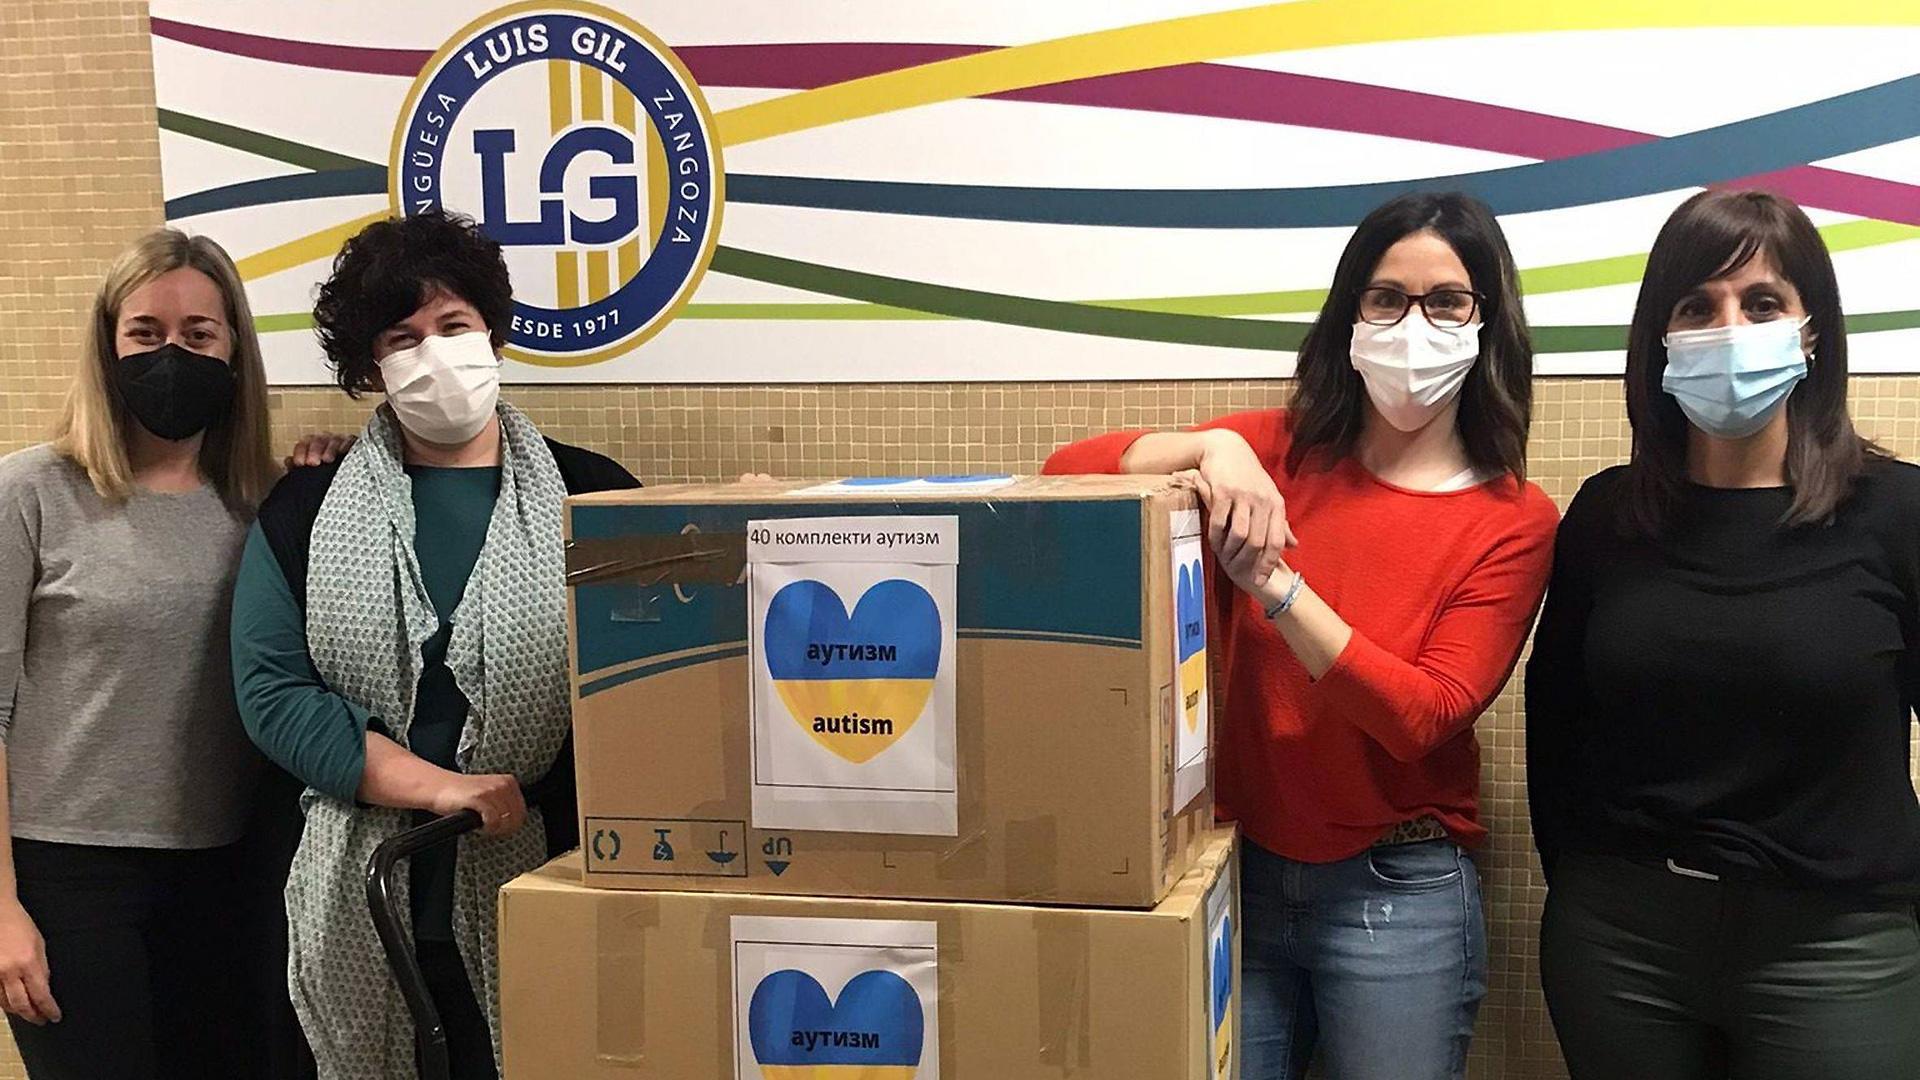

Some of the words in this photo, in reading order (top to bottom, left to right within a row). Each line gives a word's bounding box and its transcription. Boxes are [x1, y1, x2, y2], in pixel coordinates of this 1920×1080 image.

[464, 24, 549, 79] LUIS
[571, 27, 627, 71] GIL
[413, 93, 456, 214] NGÜESA
[653, 89, 700, 244] ZANGOZA
[473, 126, 639, 246] LG
[511, 315, 563, 339] ESDE
[573, 309, 620, 337] 1977
[750, 529, 771, 545] 40
[775, 531, 871, 545] комплекти
[876, 532, 940, 548] аутизм
[807, 643, 897, 663] аутизм
[812, 714, 893, 735] autism
[762, 838, 792, 856] UP
[791, 1030, 879, 1052] аутизм
